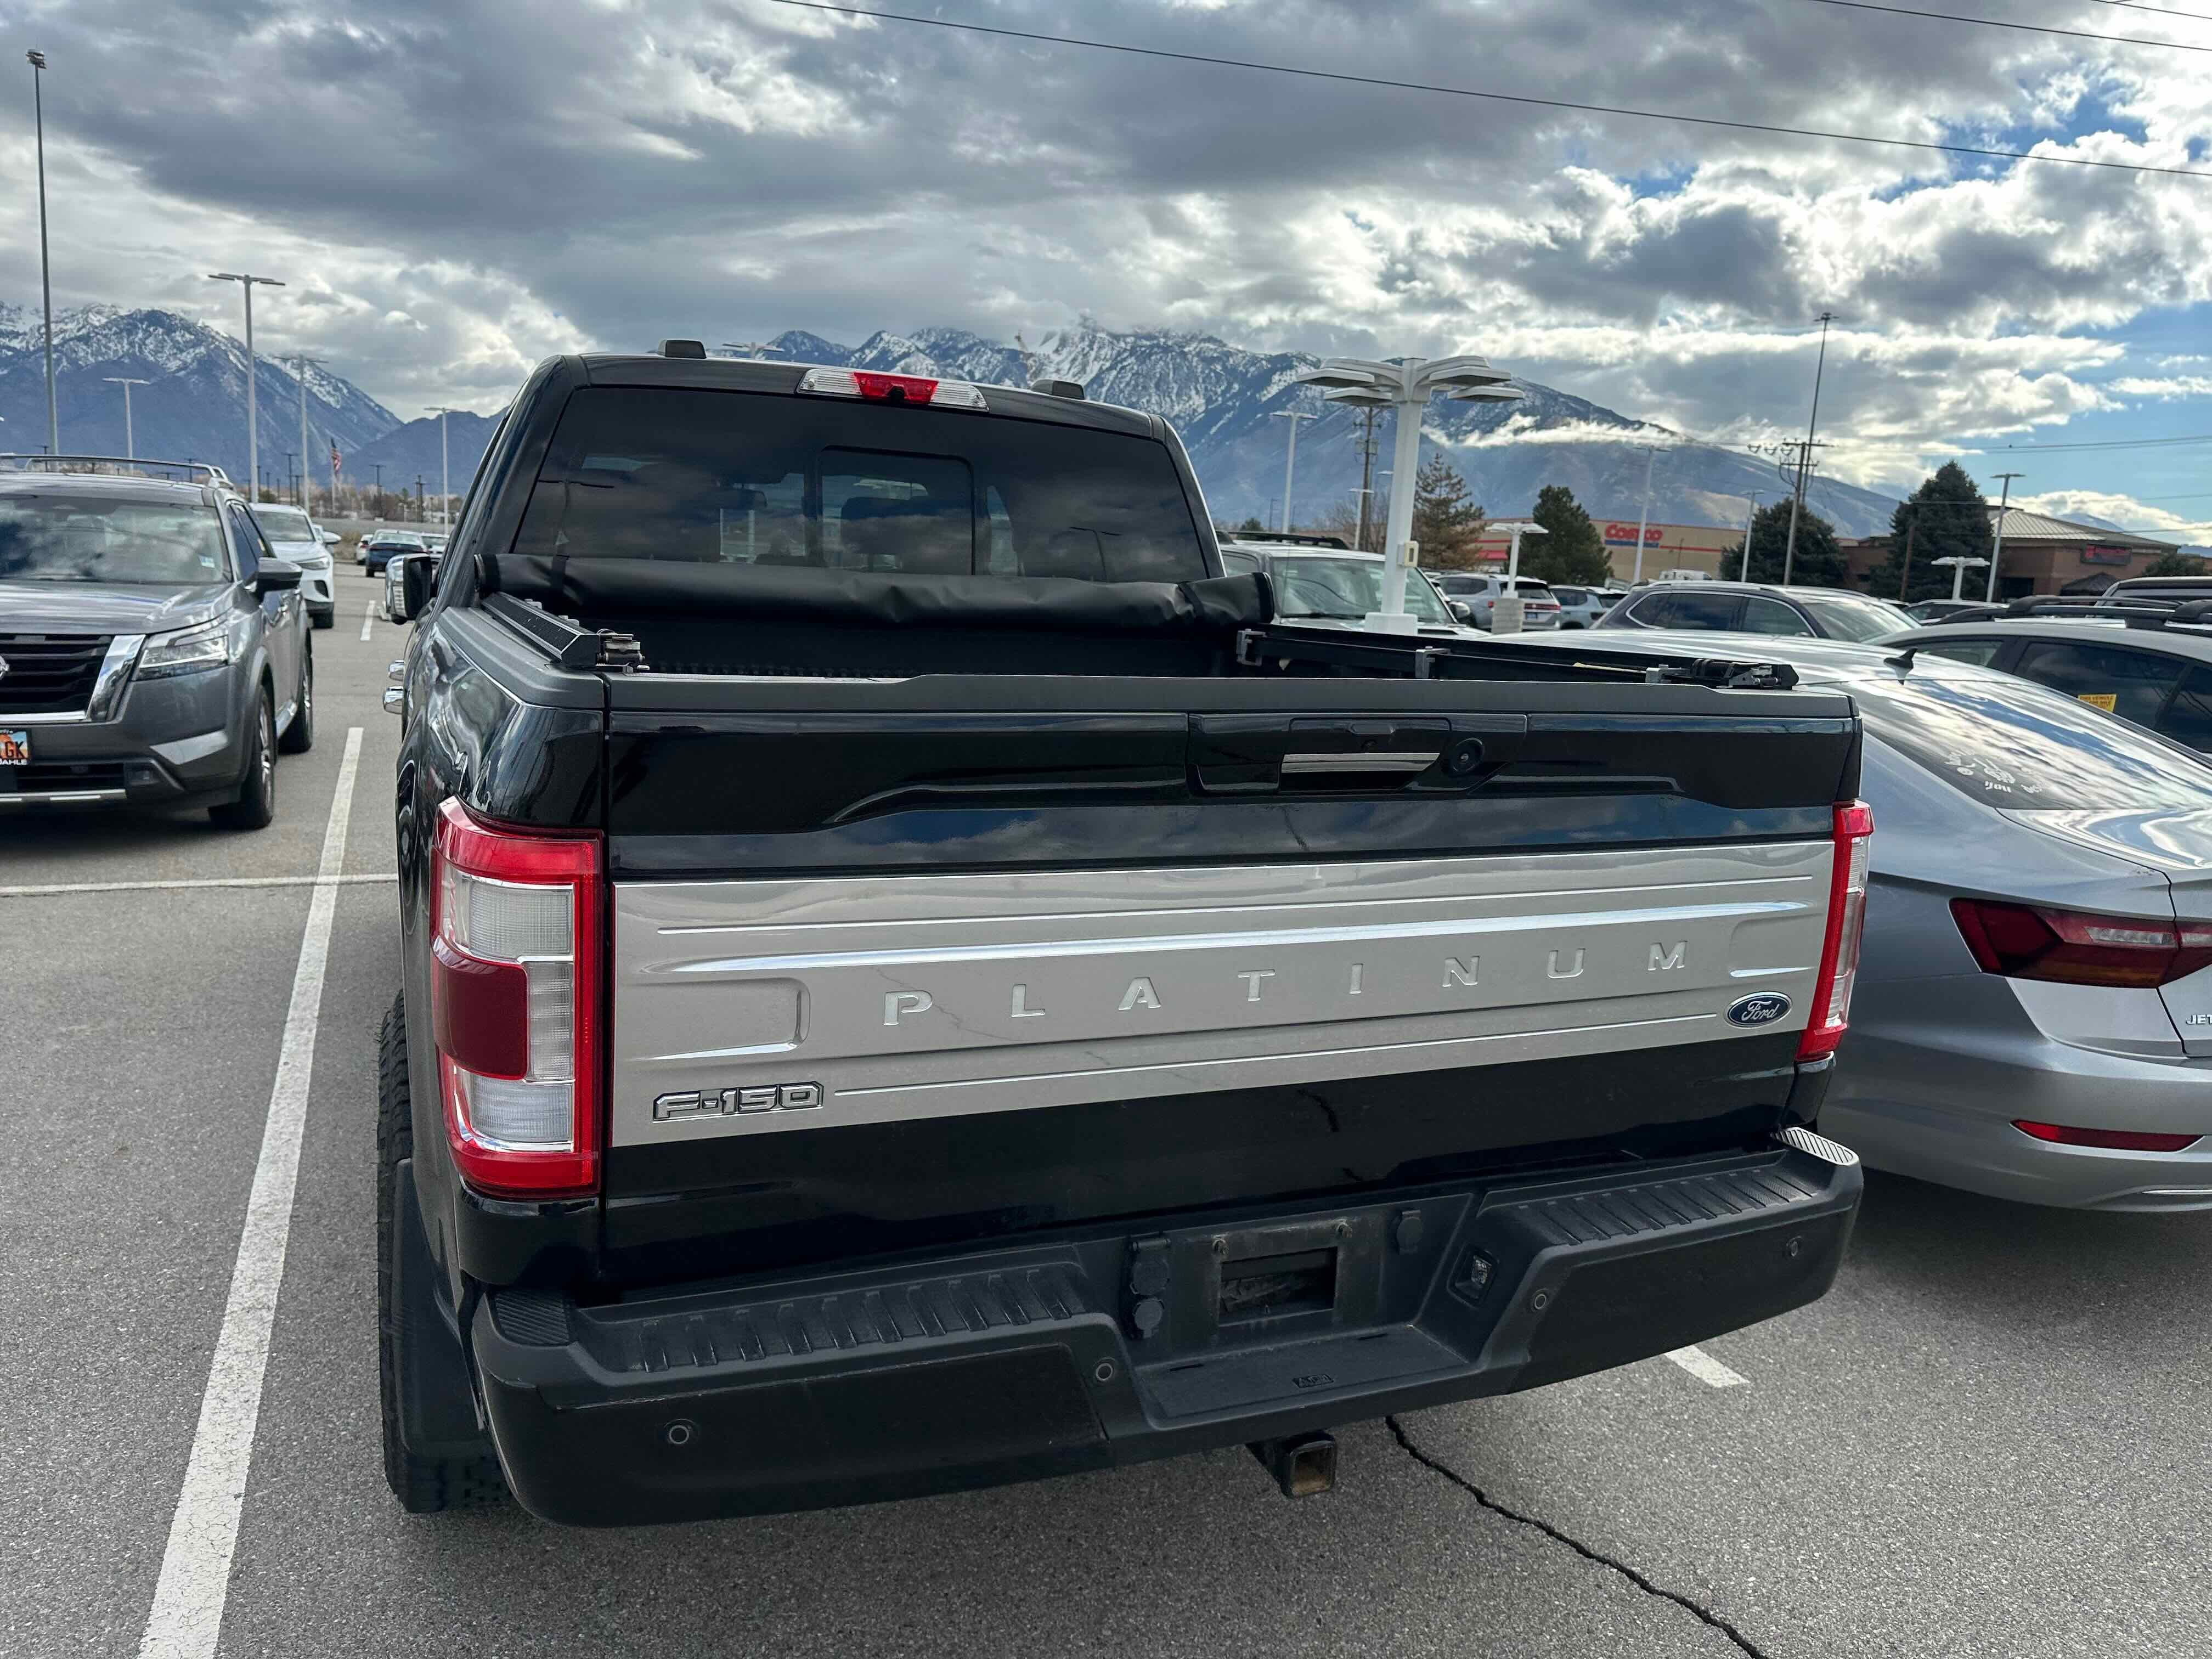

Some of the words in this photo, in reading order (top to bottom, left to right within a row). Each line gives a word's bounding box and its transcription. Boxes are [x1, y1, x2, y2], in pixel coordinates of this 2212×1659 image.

[0, 741, 26, 758] GK
[883, 940, 1688, 1026] PLATINUM
[1741, 1000, 1780, 1021] Ford
[653, 1081, 824, 1121] F-150
